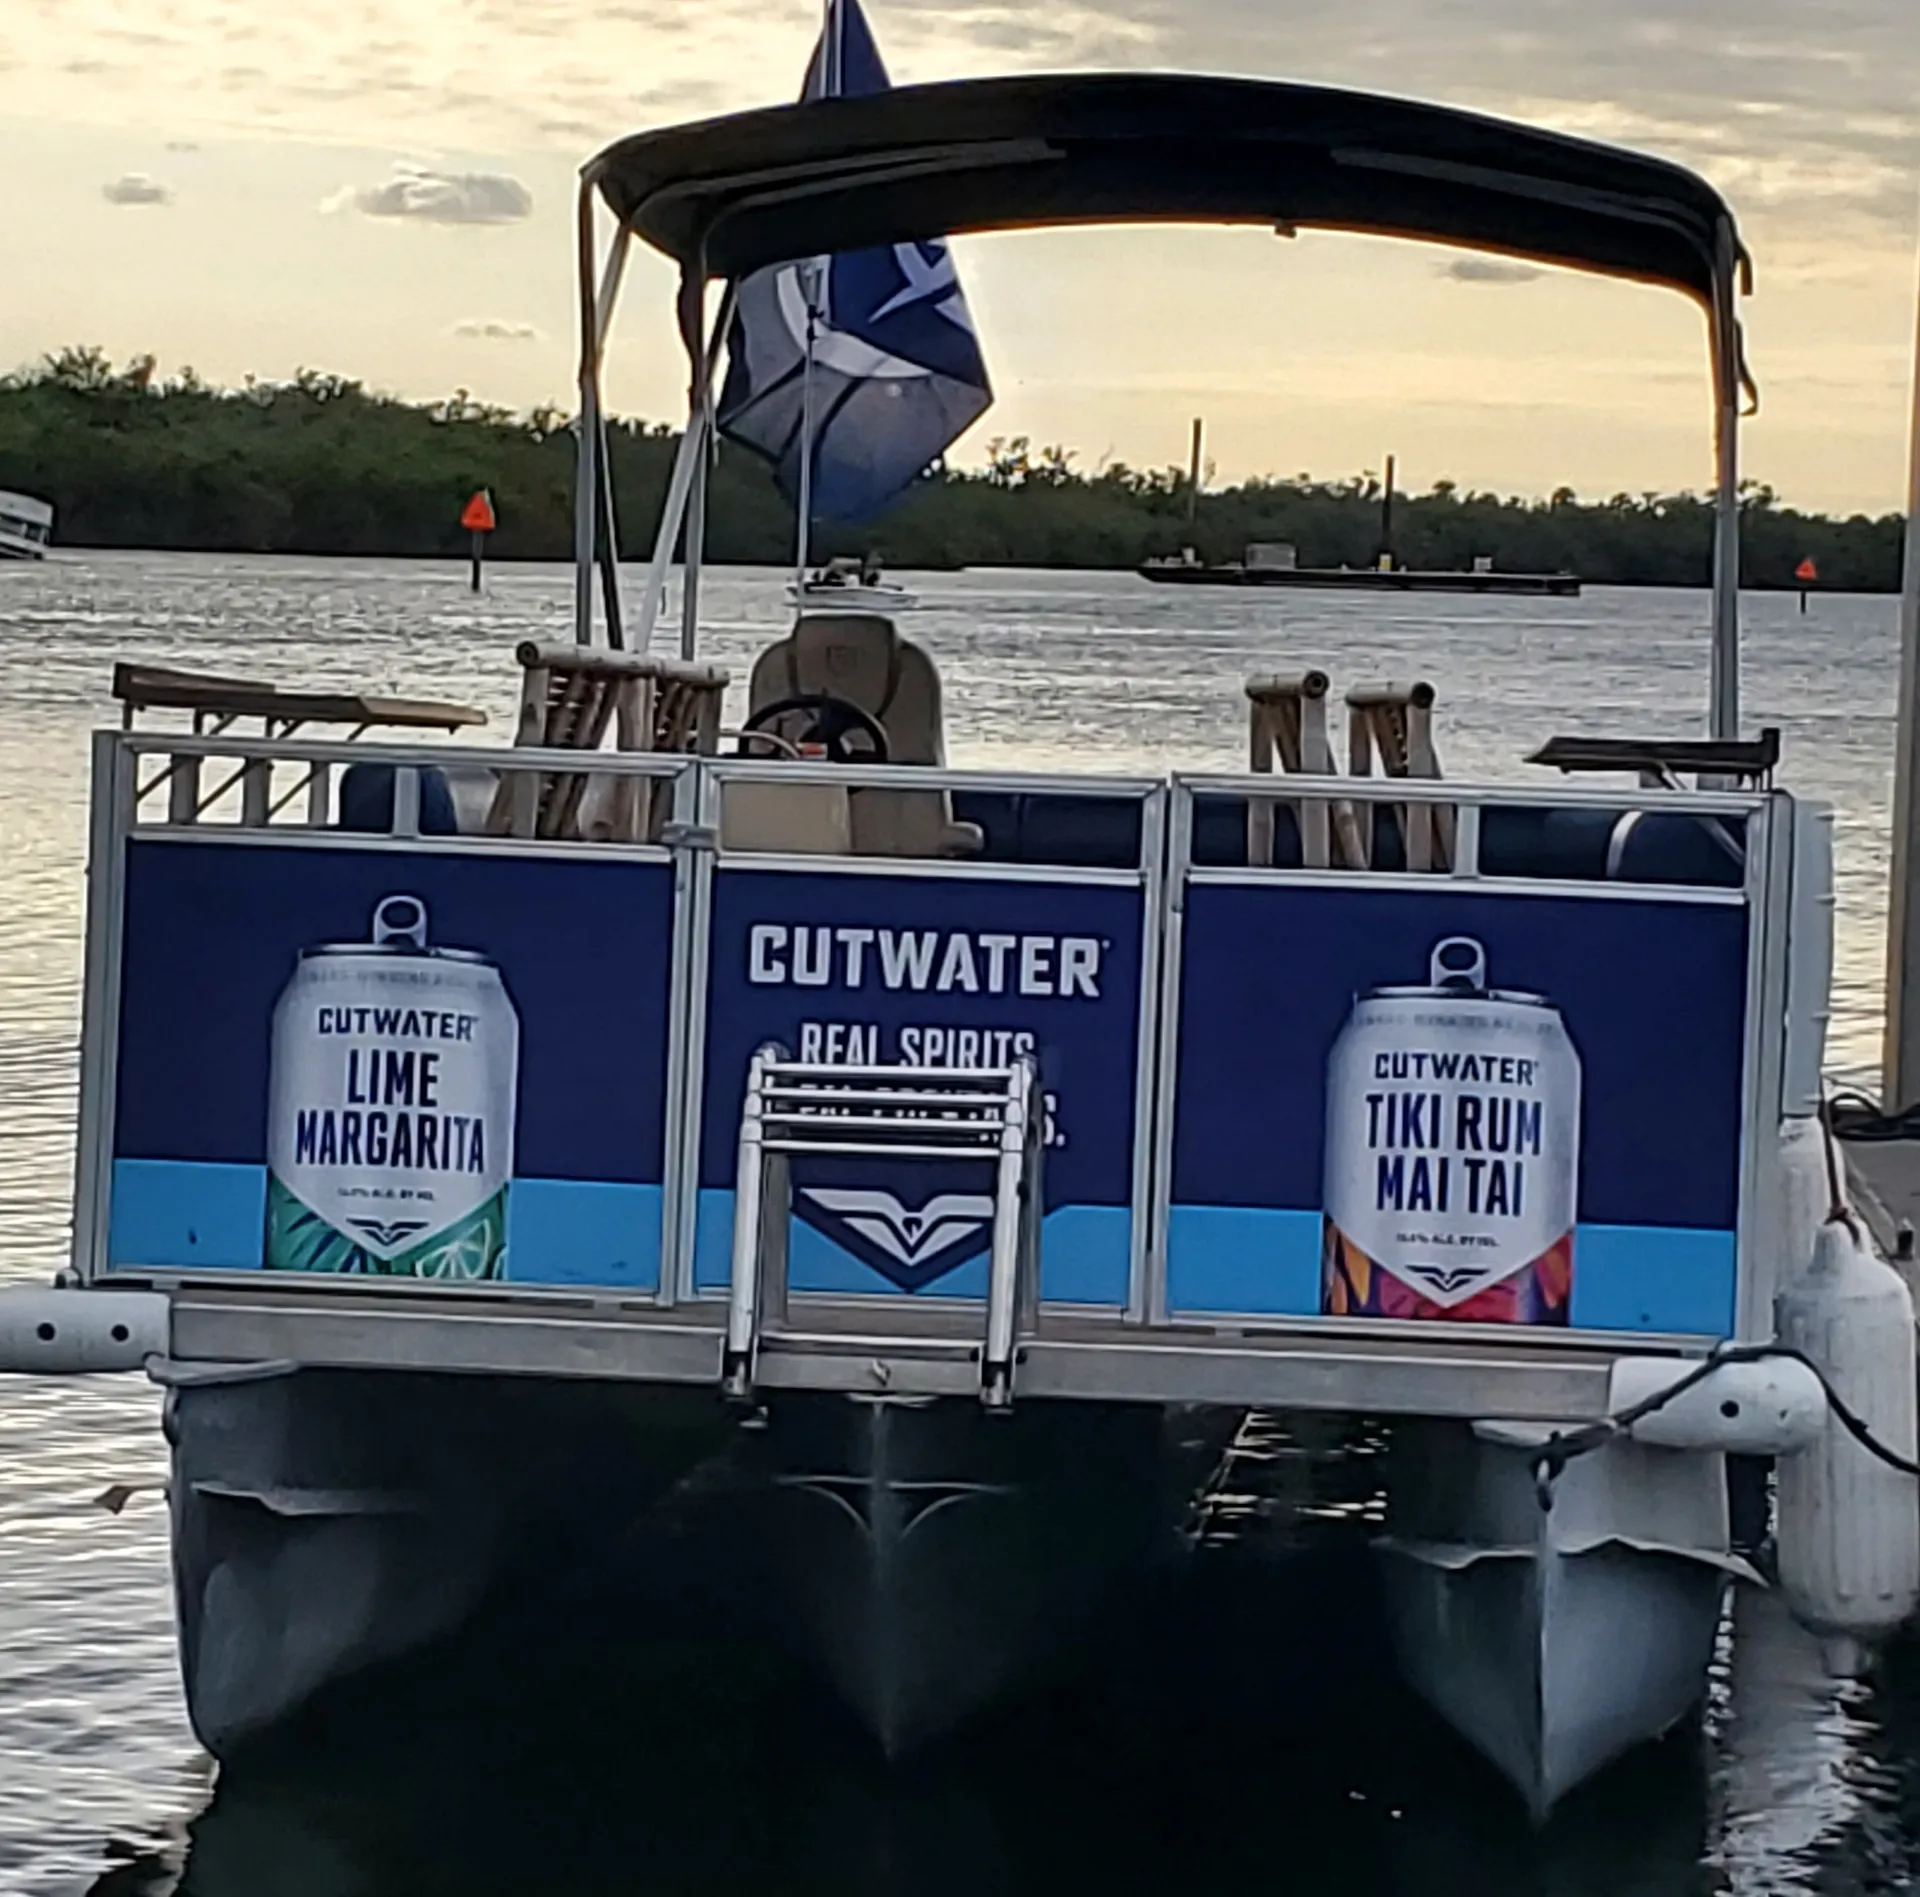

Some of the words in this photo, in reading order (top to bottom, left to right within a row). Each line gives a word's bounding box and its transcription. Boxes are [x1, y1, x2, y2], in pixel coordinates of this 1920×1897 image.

[749, 924, 1101, 997] CUTWATER
[318, 1007, 473, 1042] CUTWATER
[347, 1049, 440, 1108] LIME
[1374, 1052, 1533, 1086] CUTWATER
[295, 1109, 485, 1174] MARGARITA
[1365, 1093, 1443, 1150] TIKI
[1456, 1095, 1542, 1156] RUM
[1376, 1155, 1449, 1212] MAI
[1463, 1158, 1523, 1216] TAI
